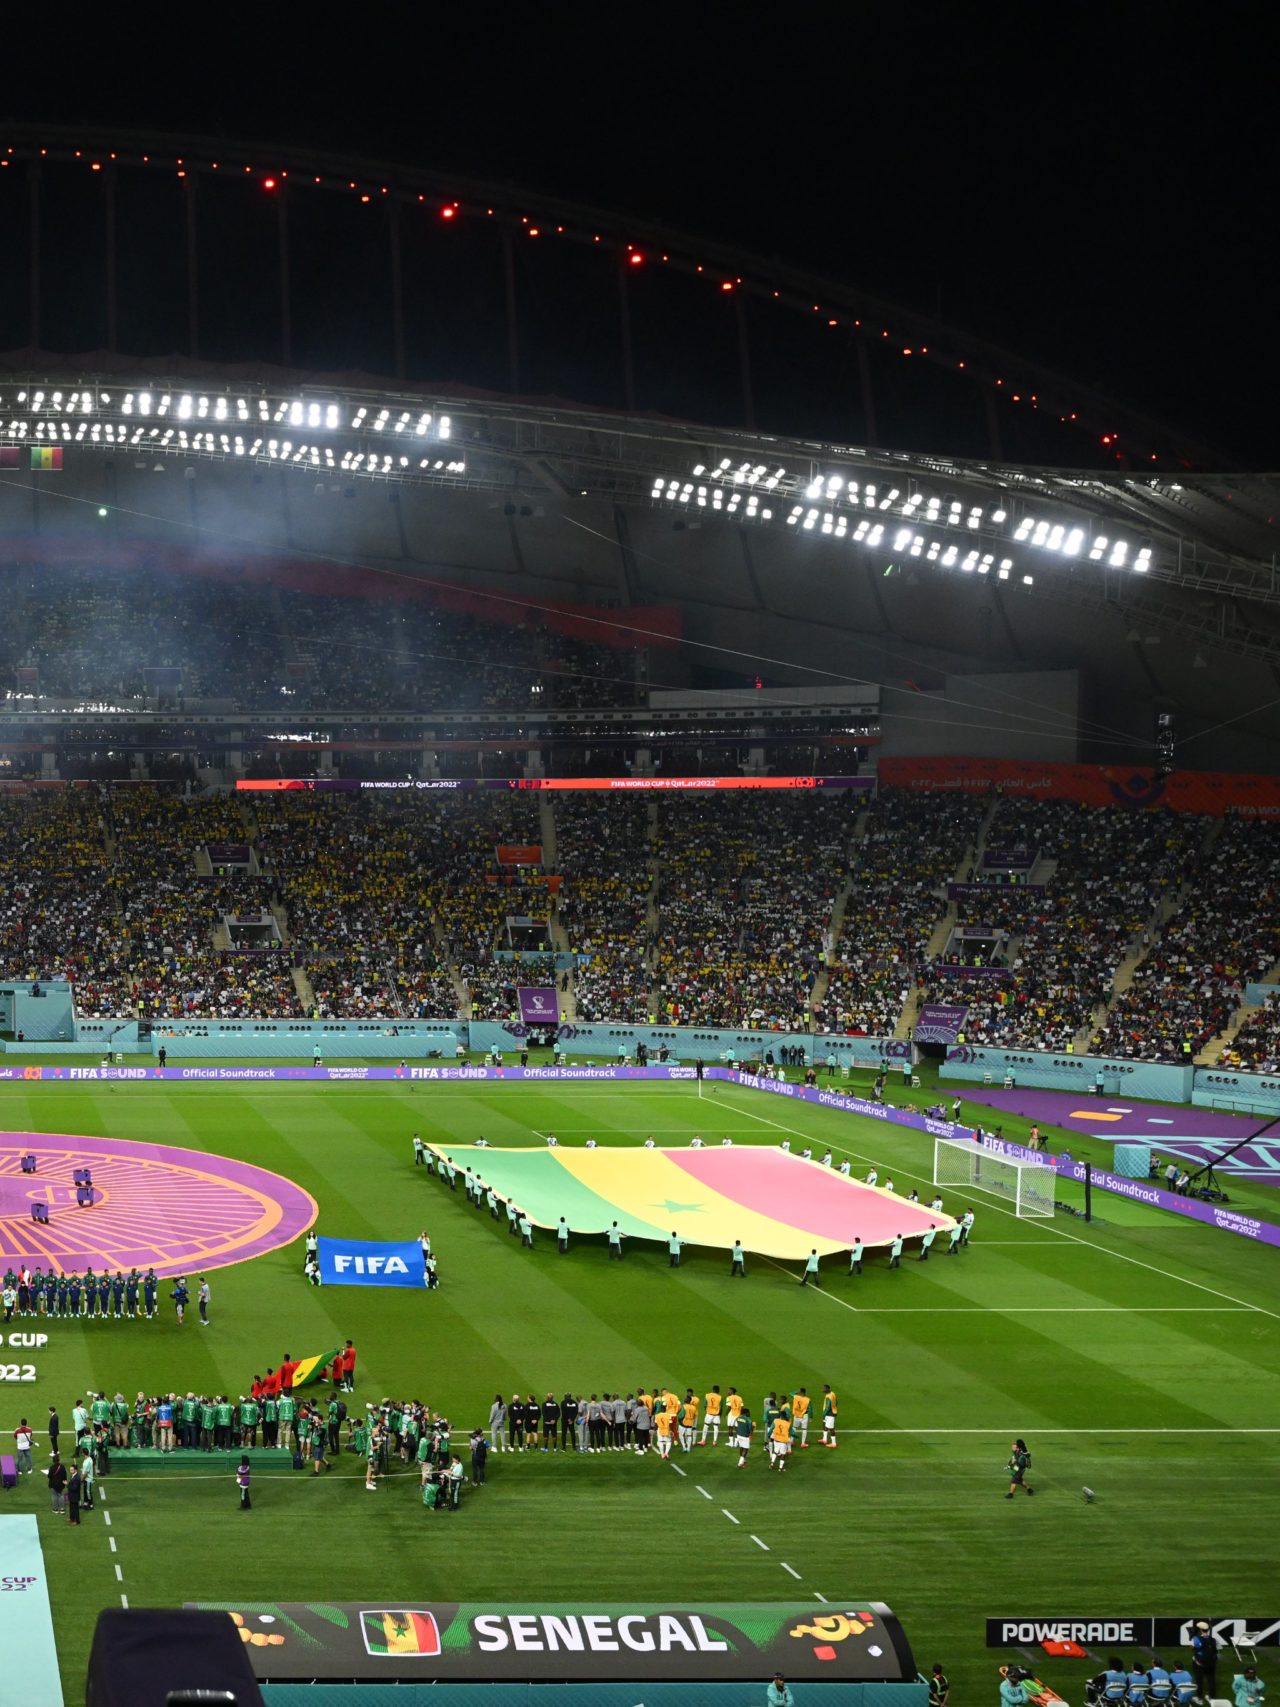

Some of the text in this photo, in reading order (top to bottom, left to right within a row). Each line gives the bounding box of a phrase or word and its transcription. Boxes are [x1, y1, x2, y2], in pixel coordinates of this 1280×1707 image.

[70, 1069, 98, 1078] FIFA
[412, 1068, 439, 1078] FIFA
[524, 1069, 616, 1077] Official Soundtrack
[740, 1073, 759, 1088] FIFA
[819, 1093, 888, 1118] Official Soundtrack
[984, 1136, 1005, 1154] FIFA
[1074, 1167, 1160, 1204] Offcial Soundtrack
[1214, 1208, 1260, 1228] FIFA WORLD CUP
[334, 1255, 409, 1274] FIFA
[8, 1333, 48, 1347] CUP
[473, 1614, 728, 1650] SENEGAL
[1002, 1623, 1134, 1642] POWERADE
